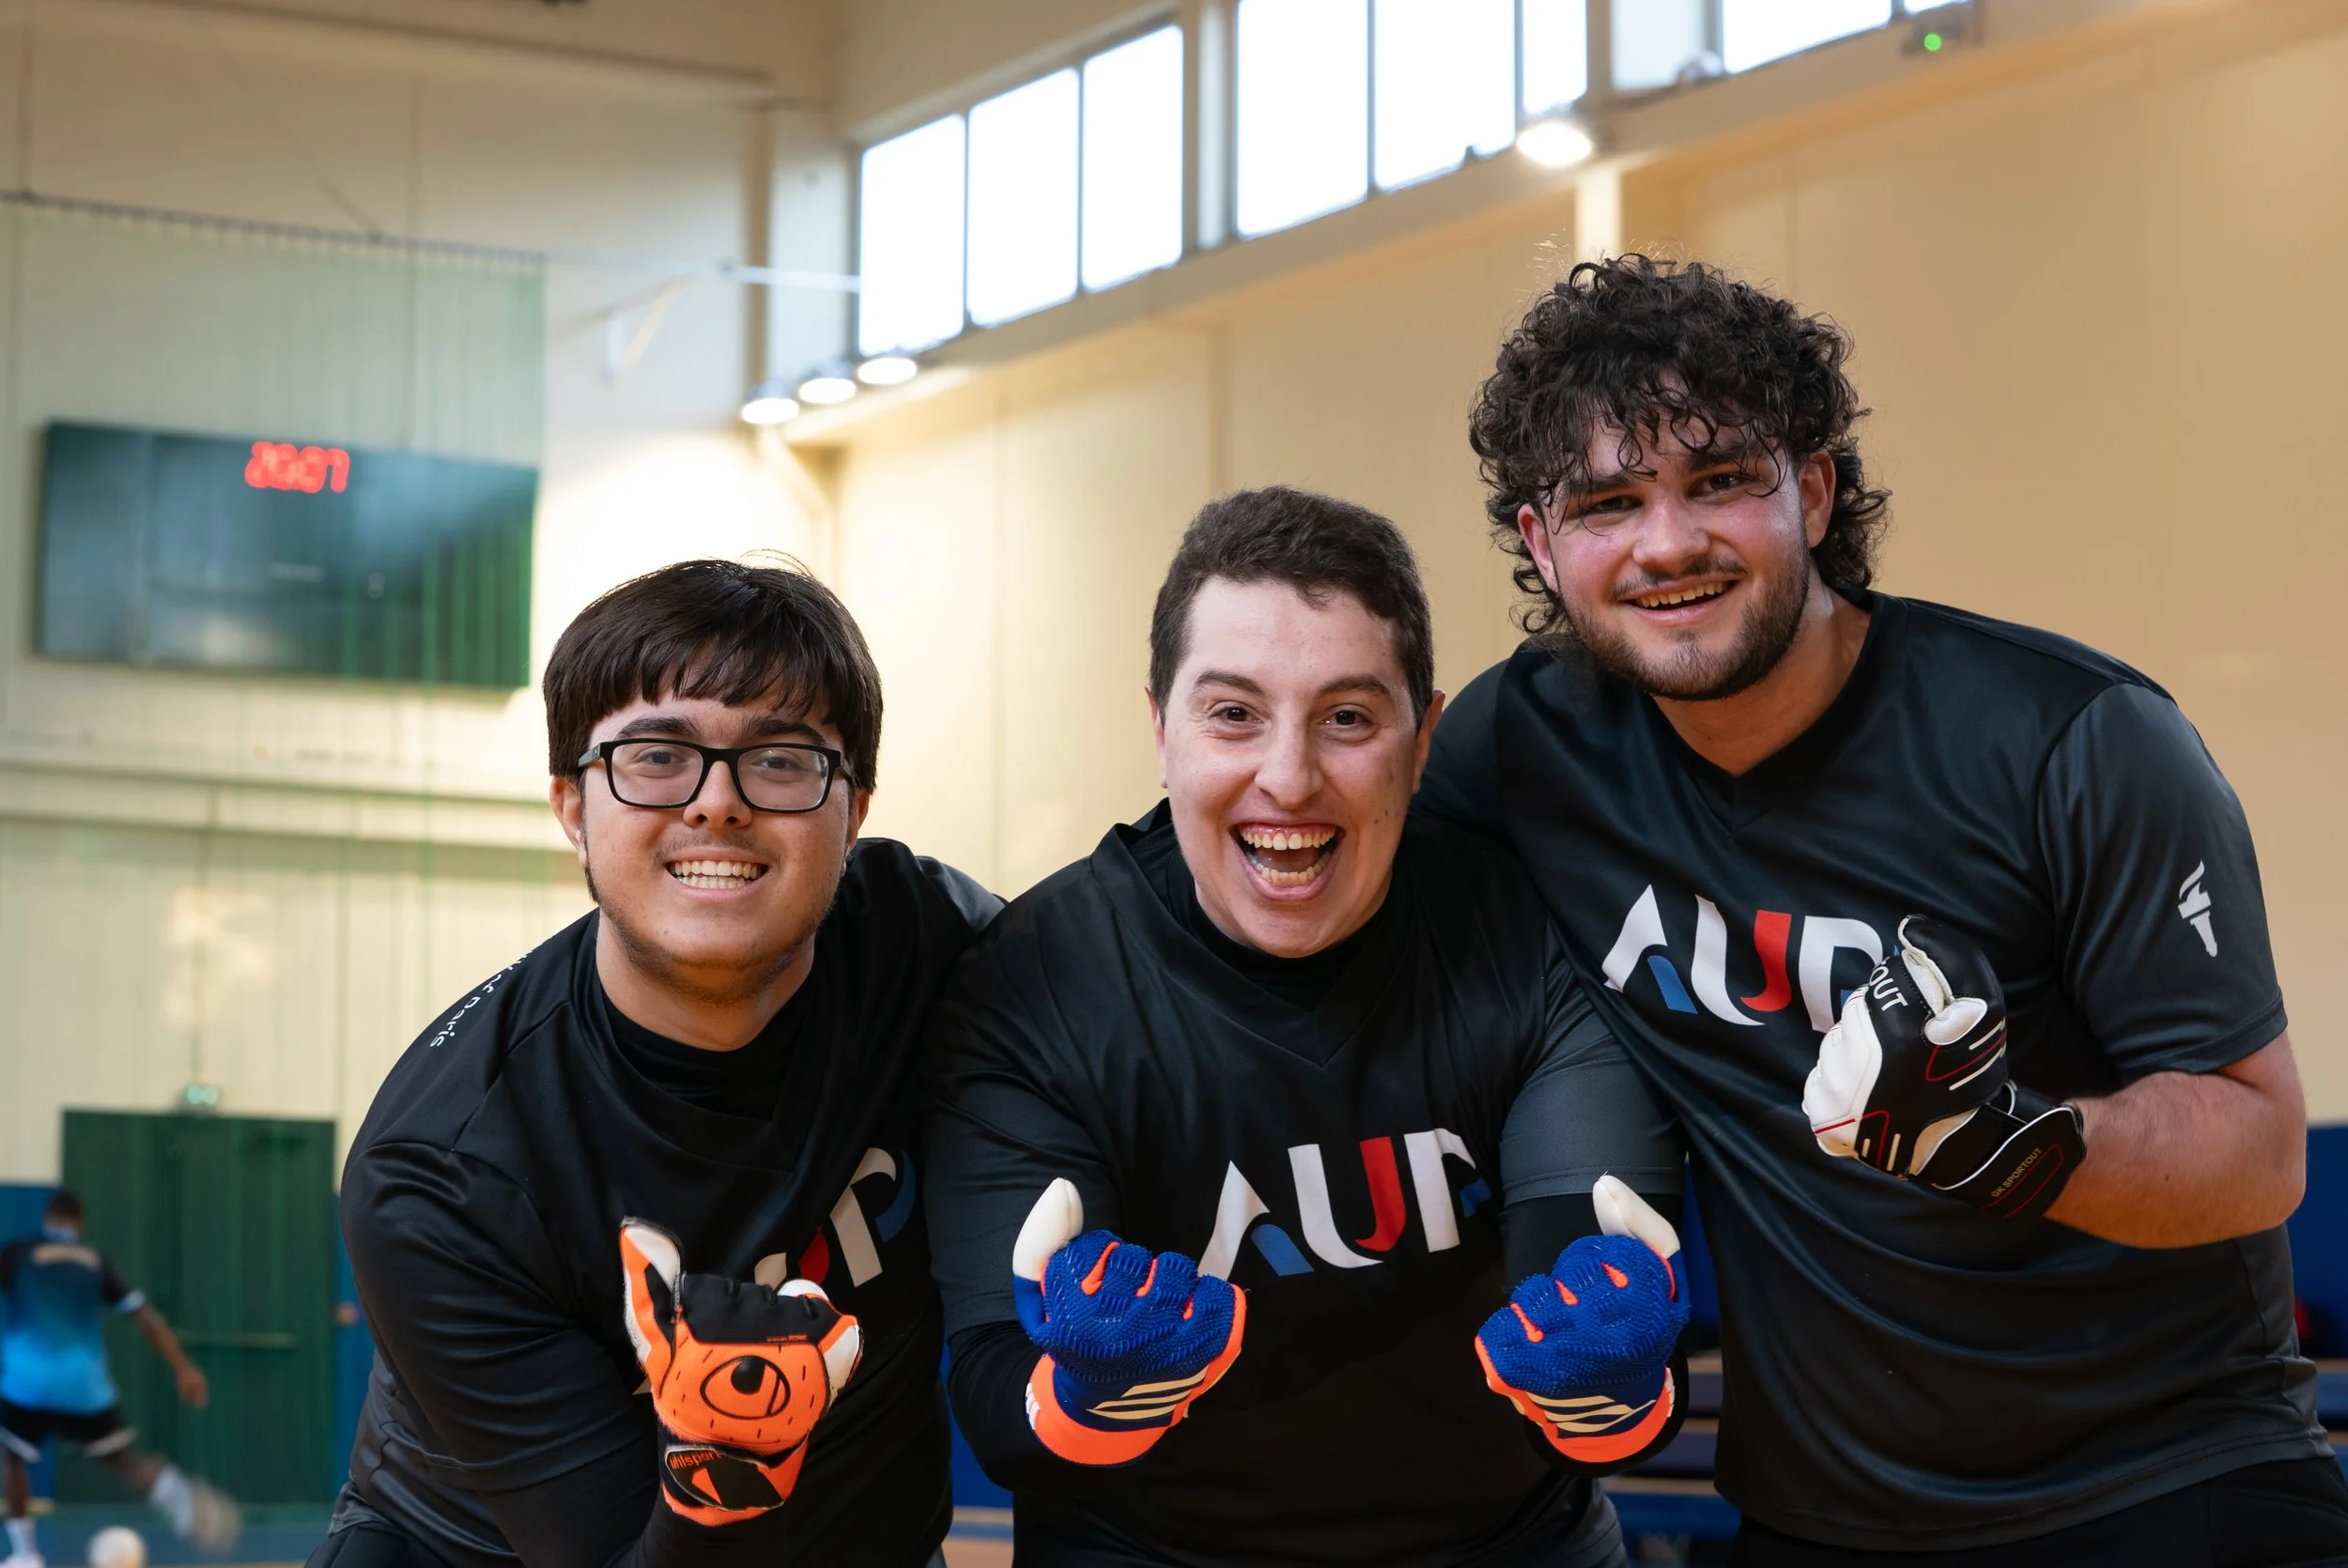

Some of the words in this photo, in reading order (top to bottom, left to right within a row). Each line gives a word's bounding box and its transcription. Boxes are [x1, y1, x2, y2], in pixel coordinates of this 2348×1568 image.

[1601, 884, 1890, 1033] AUP
[1197, 1128, 1492, 1282] AUP
[1991, 1187, 2006, 1197] GK
[2002, 1147, 2042, 1188] SPORTOUT
